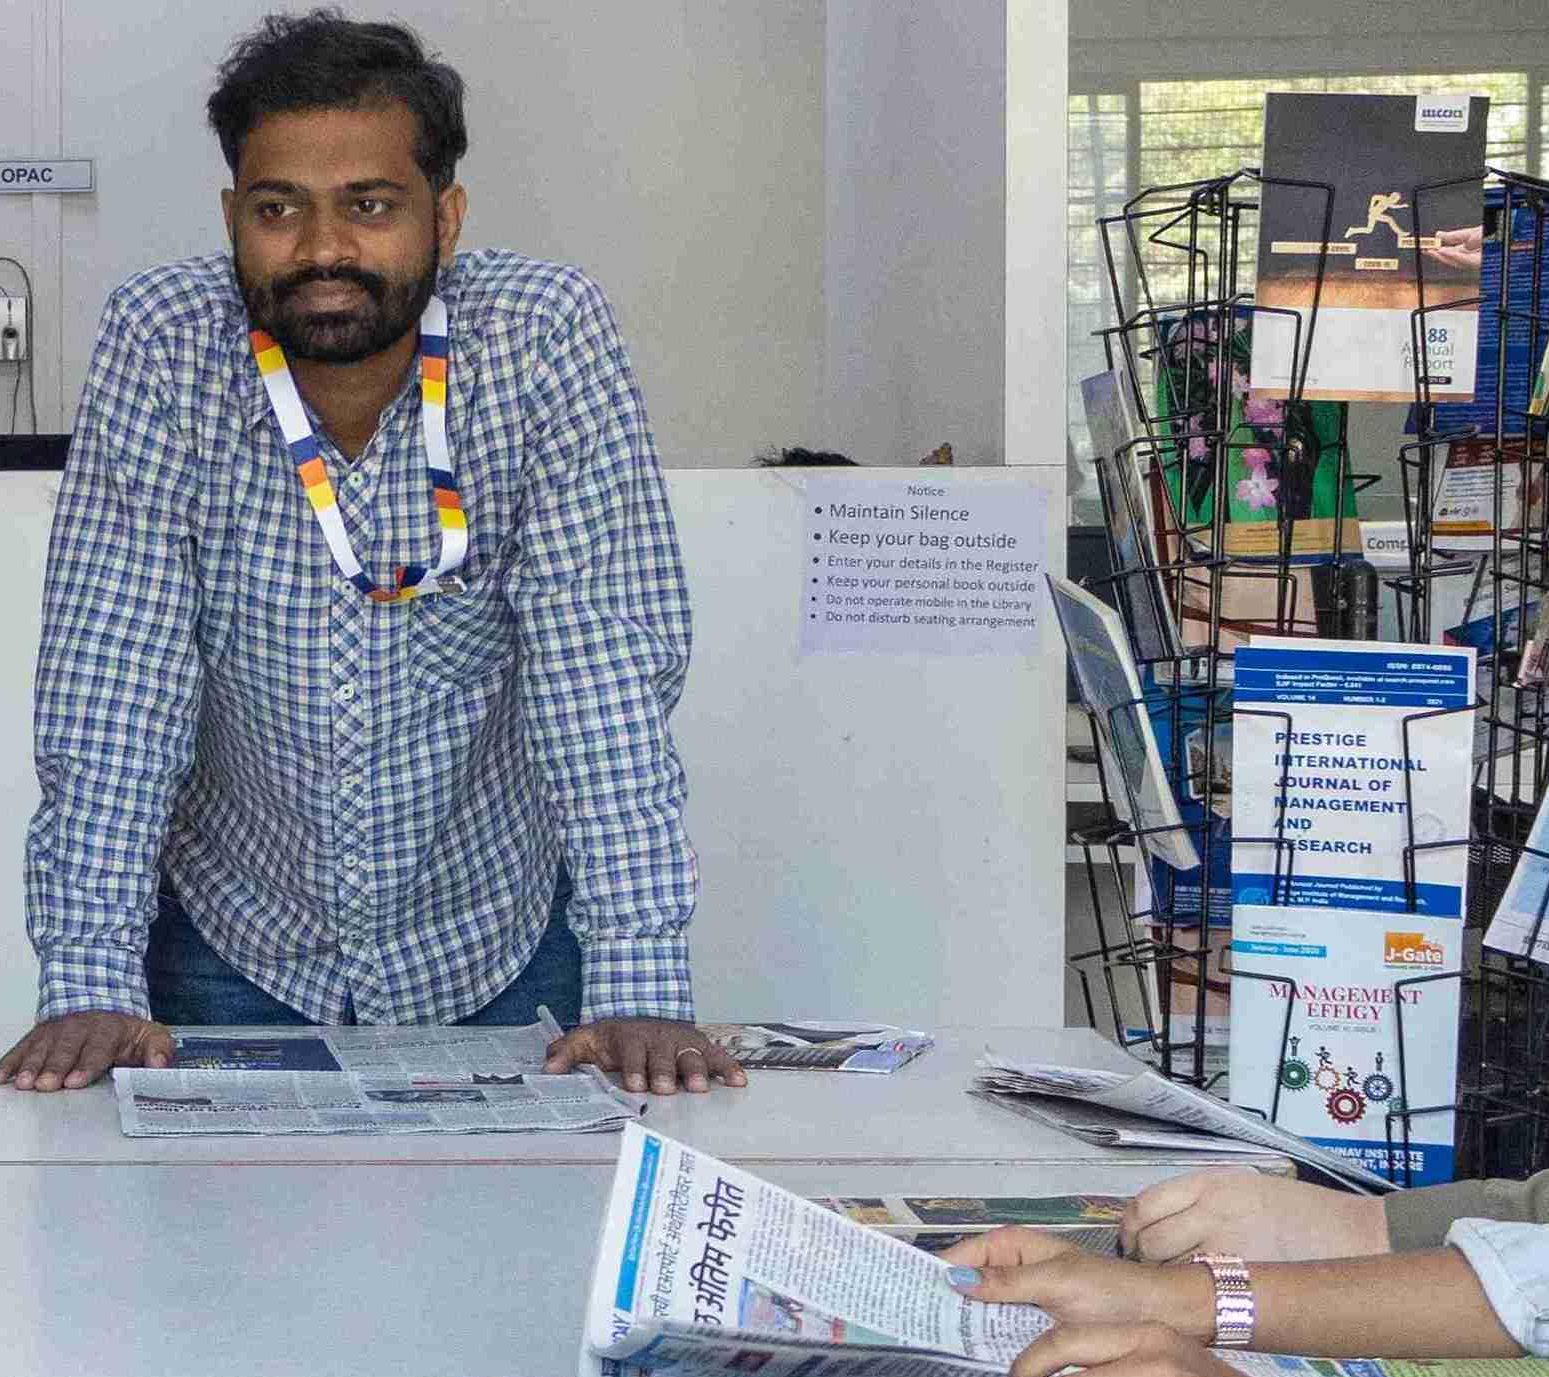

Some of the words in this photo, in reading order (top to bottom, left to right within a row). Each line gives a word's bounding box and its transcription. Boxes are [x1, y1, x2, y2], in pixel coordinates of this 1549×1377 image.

[1, 167, 54, 184] OPAC
[1428, 328, 1448, 343] 88
[907, 485, 946, 497] Notice
[830, 504, 905, 521] Maintain
[910, 505, 970, 522] Silence
[828, 529, 871, 546] Keep
[875, 533, 915, 548] your
[919, 531, 950, 550] bag
[954, 532, 1017, 549] outside
[827, 555, 863, 569] Enter
[866, 558, 895, 571] your
[898, 557, 942, 570] details
[945, 558, 957, 570] in
[960, 558, 983, 571] the
[986, 559, 1040, 575] Register
[826, 575, 859, 590] Keep
[863, 578, 891, 591] your
[894, 578, 950, 593] personal
[953, 578, 985, 592] book
[988, 579, 1036, 593] outside
[826, 593, 842, 605] Do
[845, 594, 864, 606] not
[867, 596, 913, 609] operate
[915, 595, 954, 609] mobile
[957, 597, 967, 609] in
[971, 597, 990, 610] the
[992, 599, 1032, 613] Library
[825, 611, 842, 623] Do
[845, 611, 865, 624] not
[868, 612, 910, 625] disturb
[913, 614, 956, 628] seating
[958, 615, 1037, 630] arrangement
[1275, 732, 1368, 747] PRESTIGE
[1274, 754, 1428, 773] INTERNATIONAL
[1274, 777, 1363, 792] JOURNAL
[1368, 779, 1393, 792] OF
[1274, 796, 1409, 815] MANAGEMENT
[1274, 818, 1313, 830] AND
[1385, 947, 1444, 964] J-Gate
[1270, 982, 1423, 1005] MANAGEMENT
[1306, 1004, 1383, 1021] EFFIGY
[696, 1176, 745, 1238] फेरीत
[688, 1242, 733, 1312] अंतिम
